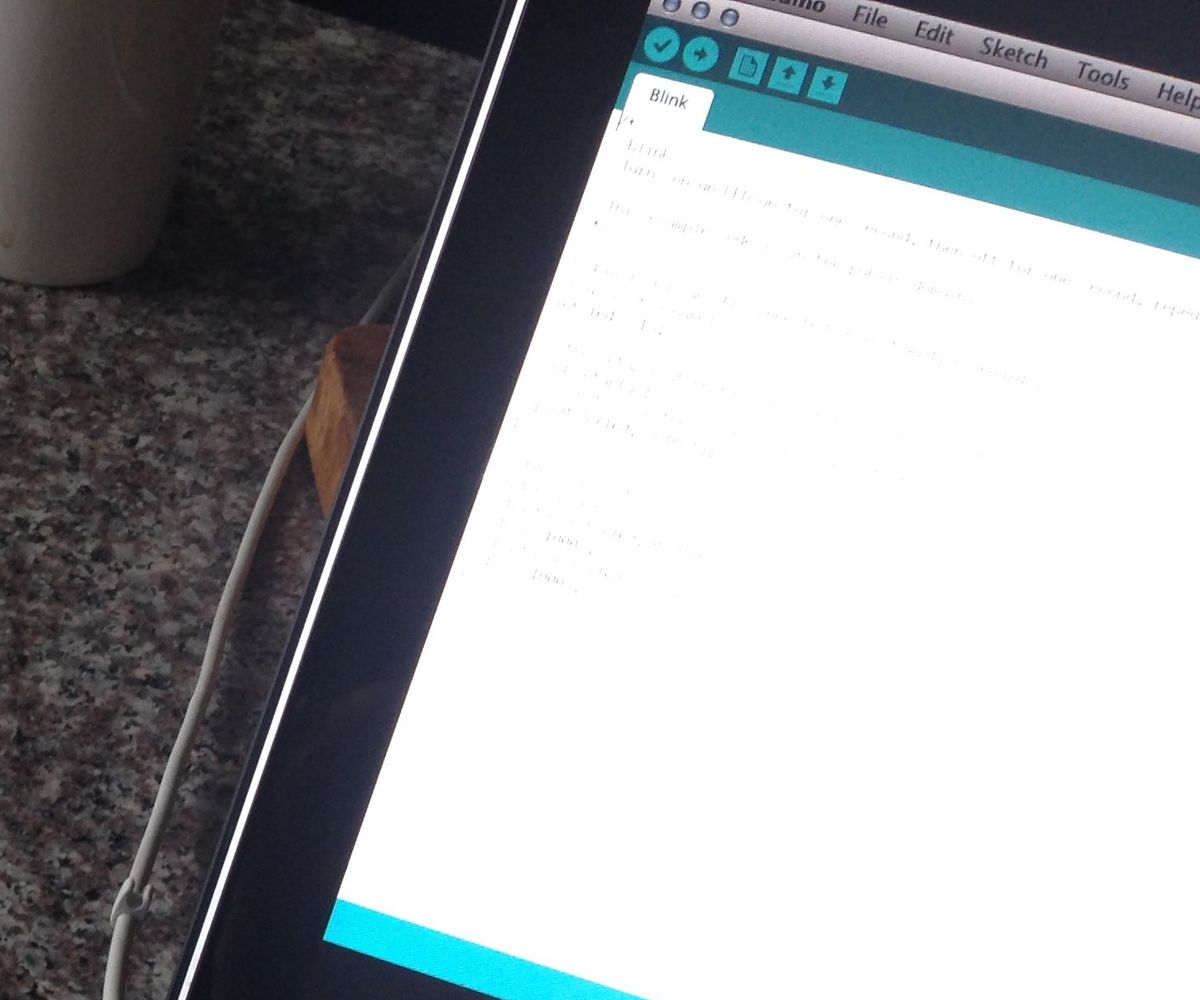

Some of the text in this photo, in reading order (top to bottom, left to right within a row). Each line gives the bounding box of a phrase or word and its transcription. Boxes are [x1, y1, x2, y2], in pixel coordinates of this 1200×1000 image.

[853, 5, 888, 29] File
[914, 20, 954, 45] Edit
[980, 36, 1048, 69] Sketch
[1078, 60, 1130, 90] Tools
[649, 88, 688, 110] Blink
